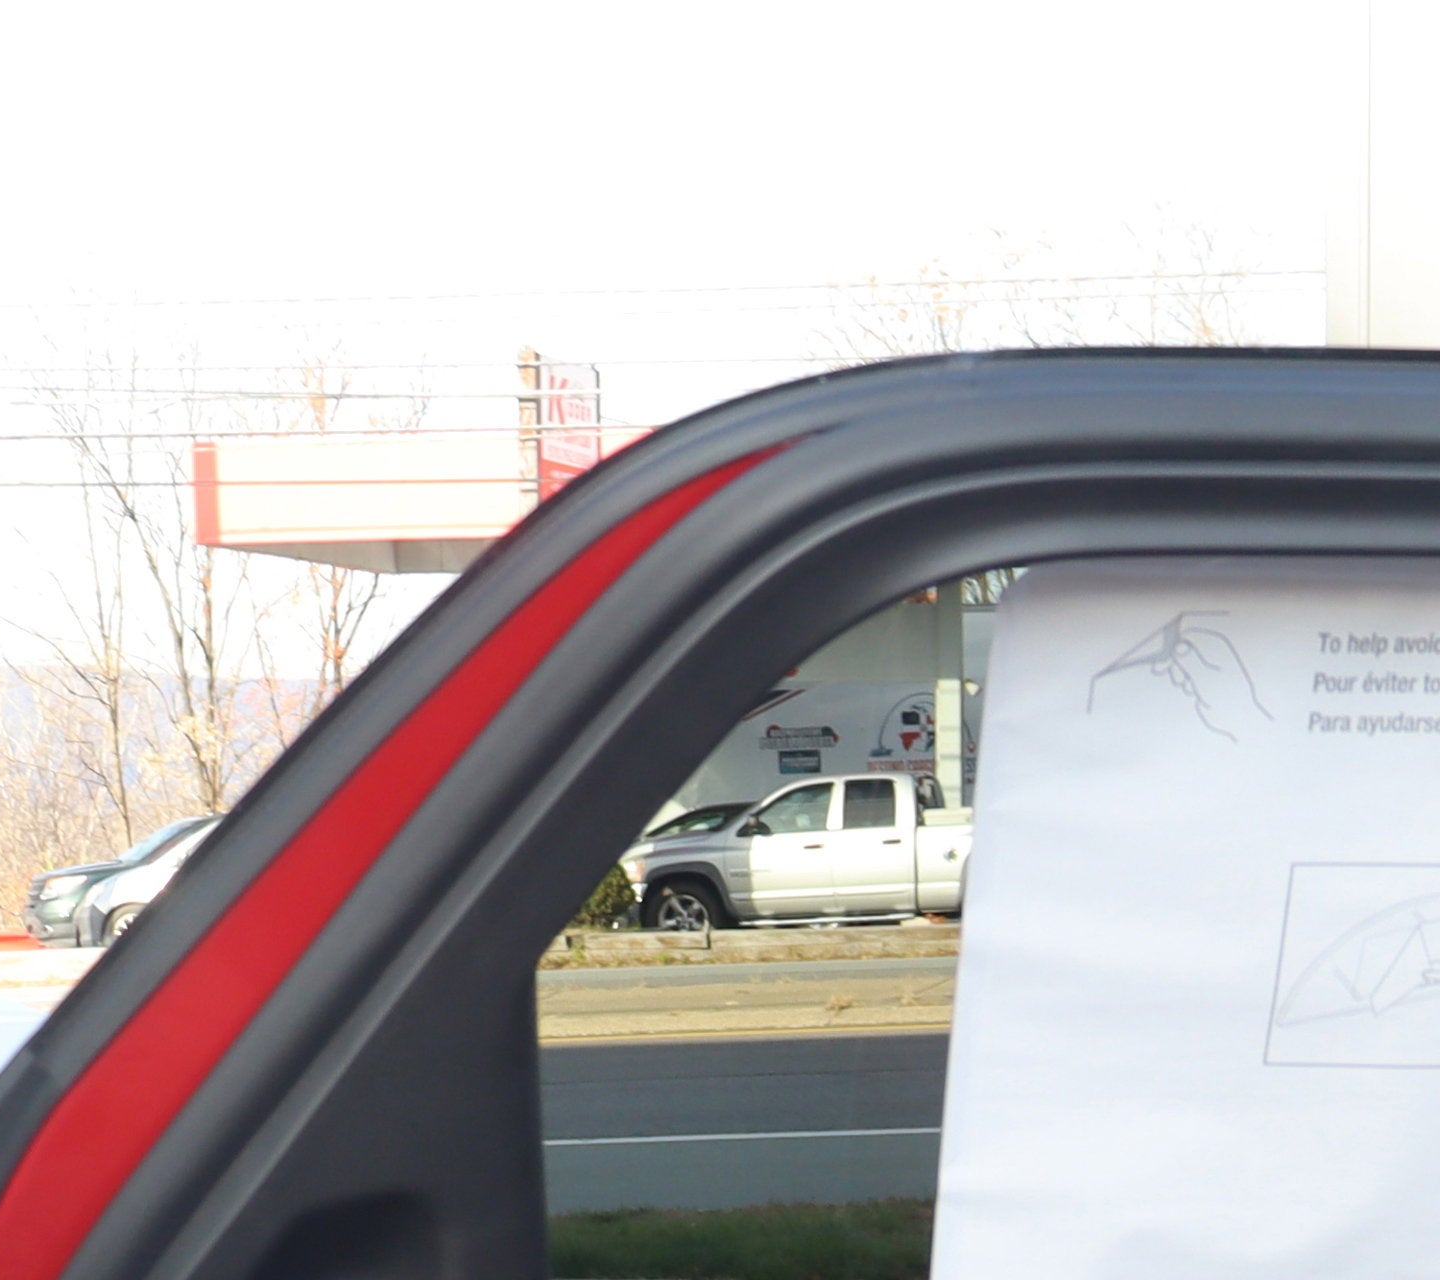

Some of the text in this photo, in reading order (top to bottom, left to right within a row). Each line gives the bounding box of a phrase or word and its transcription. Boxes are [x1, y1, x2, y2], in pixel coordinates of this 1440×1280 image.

[1317, 631, 1342, 654] To
[1346, 632, 1389, 657] help
[1312, 671, 1358, 694] Pour
[1362, 670, 1417, 694] éviter
[1307, 711, 1351, 733] Para
